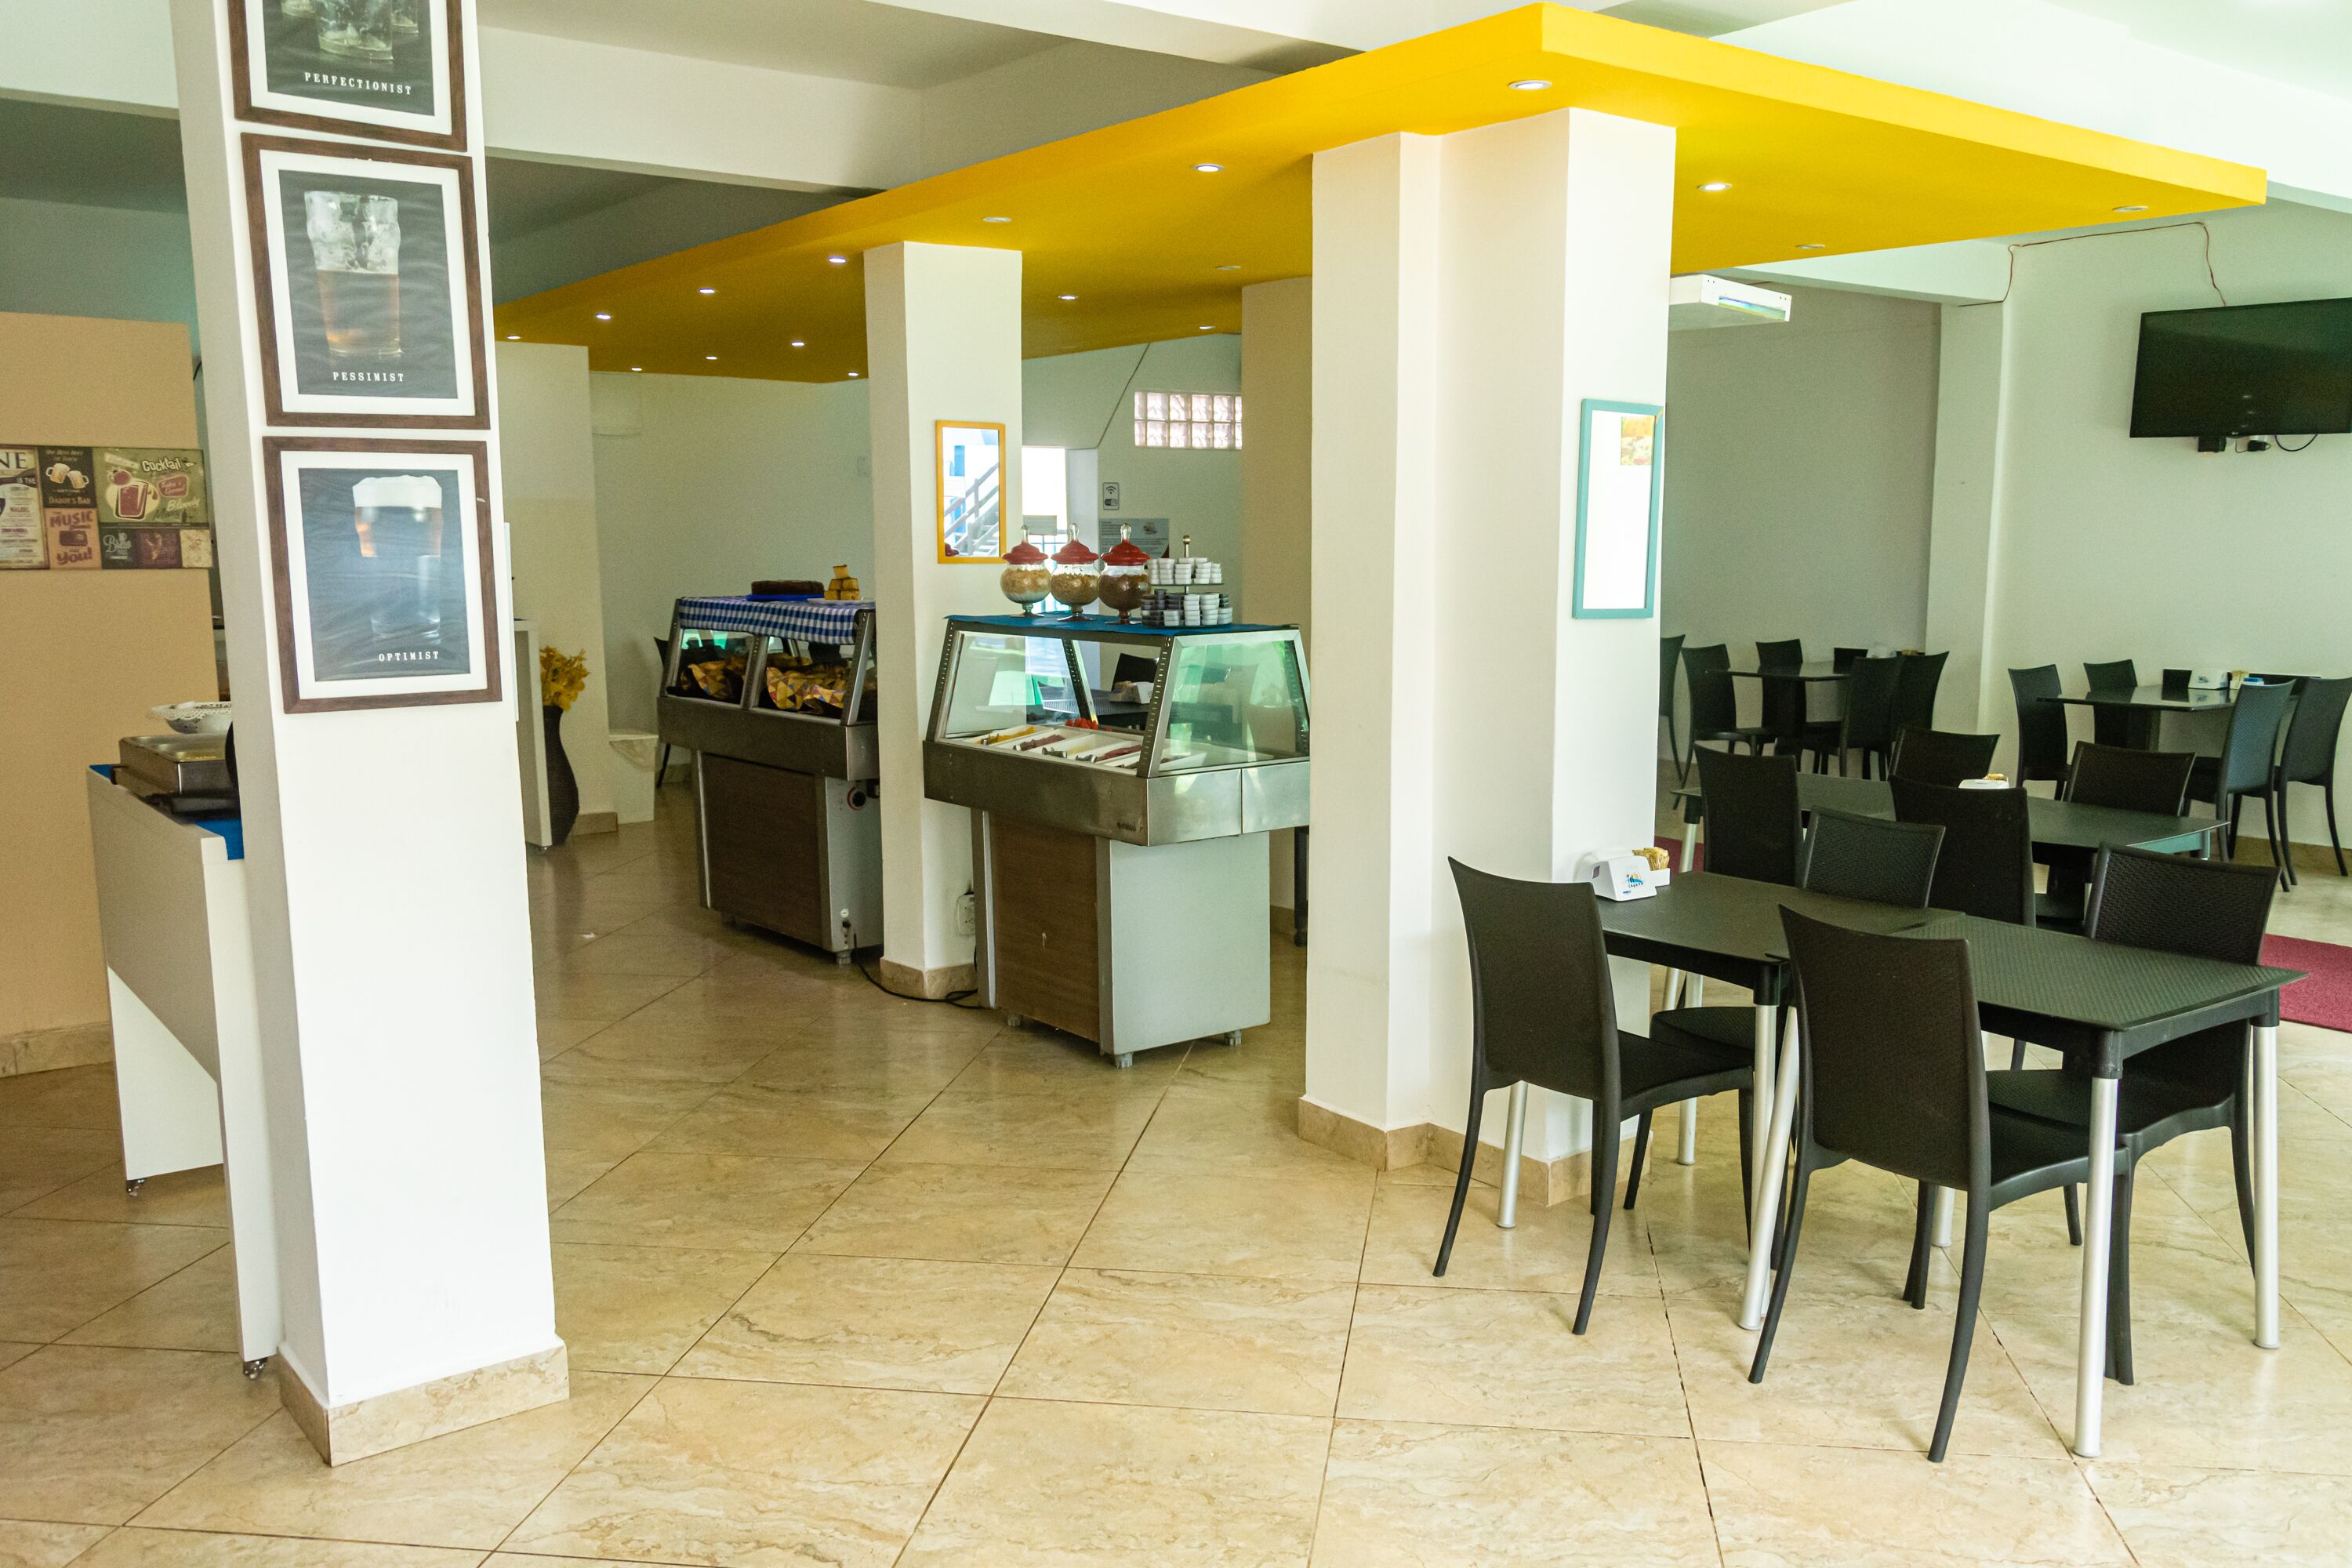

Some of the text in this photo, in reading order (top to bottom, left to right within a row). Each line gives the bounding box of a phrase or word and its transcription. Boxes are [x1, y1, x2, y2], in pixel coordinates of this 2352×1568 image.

[304, 72, 412, 95] PERFECTIONIST
[332, 372, 404, 382] PESSIMIST
[142, 457, 181, 472] Cocktail
[49, 510, 93, 528] MUSIC
[379, 651, 439, 662] OPTIMIST
